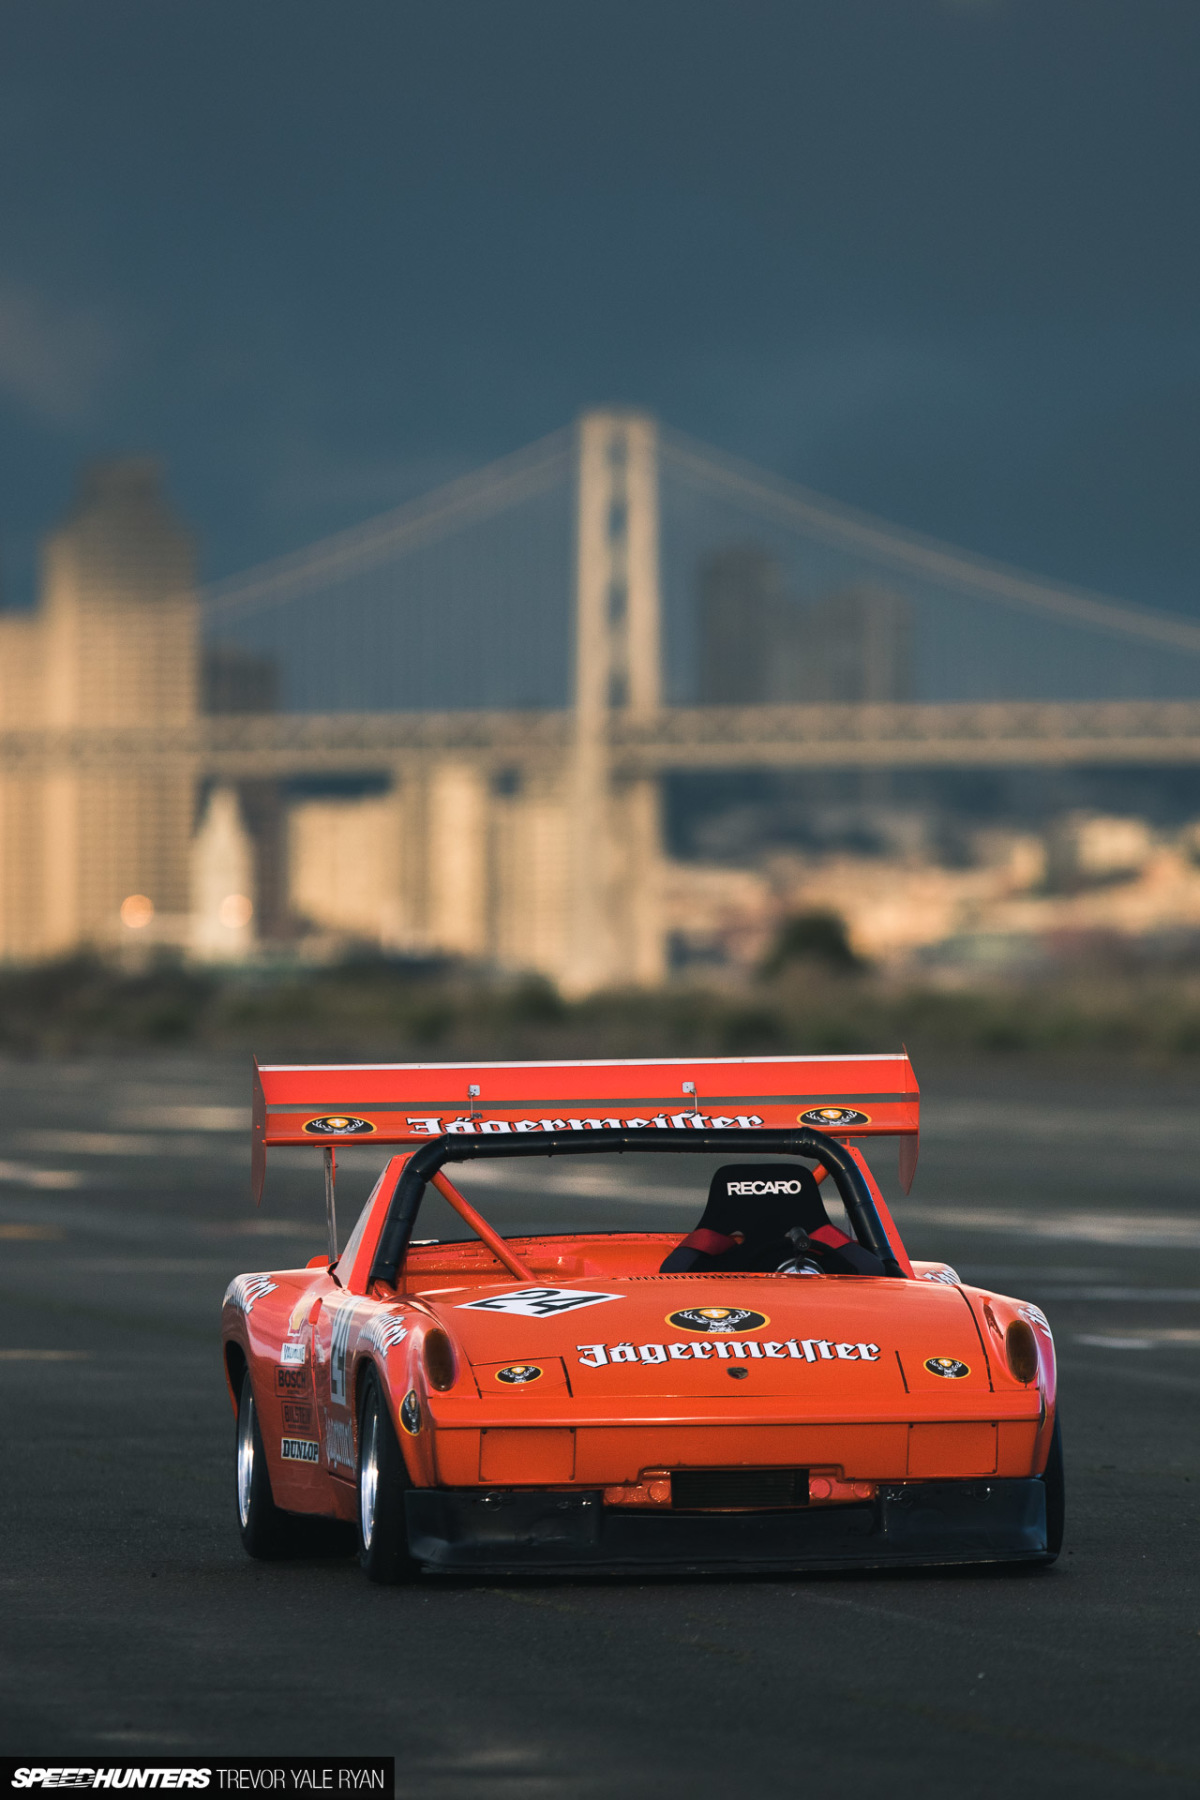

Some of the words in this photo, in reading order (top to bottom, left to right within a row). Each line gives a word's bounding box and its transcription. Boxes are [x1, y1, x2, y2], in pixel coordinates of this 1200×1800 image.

[727, 1180, 802, 1196] RECARO
[278, 1369, 307, 1389] BOSCH
[283, 1440, 319, 1461] DUNLOP
